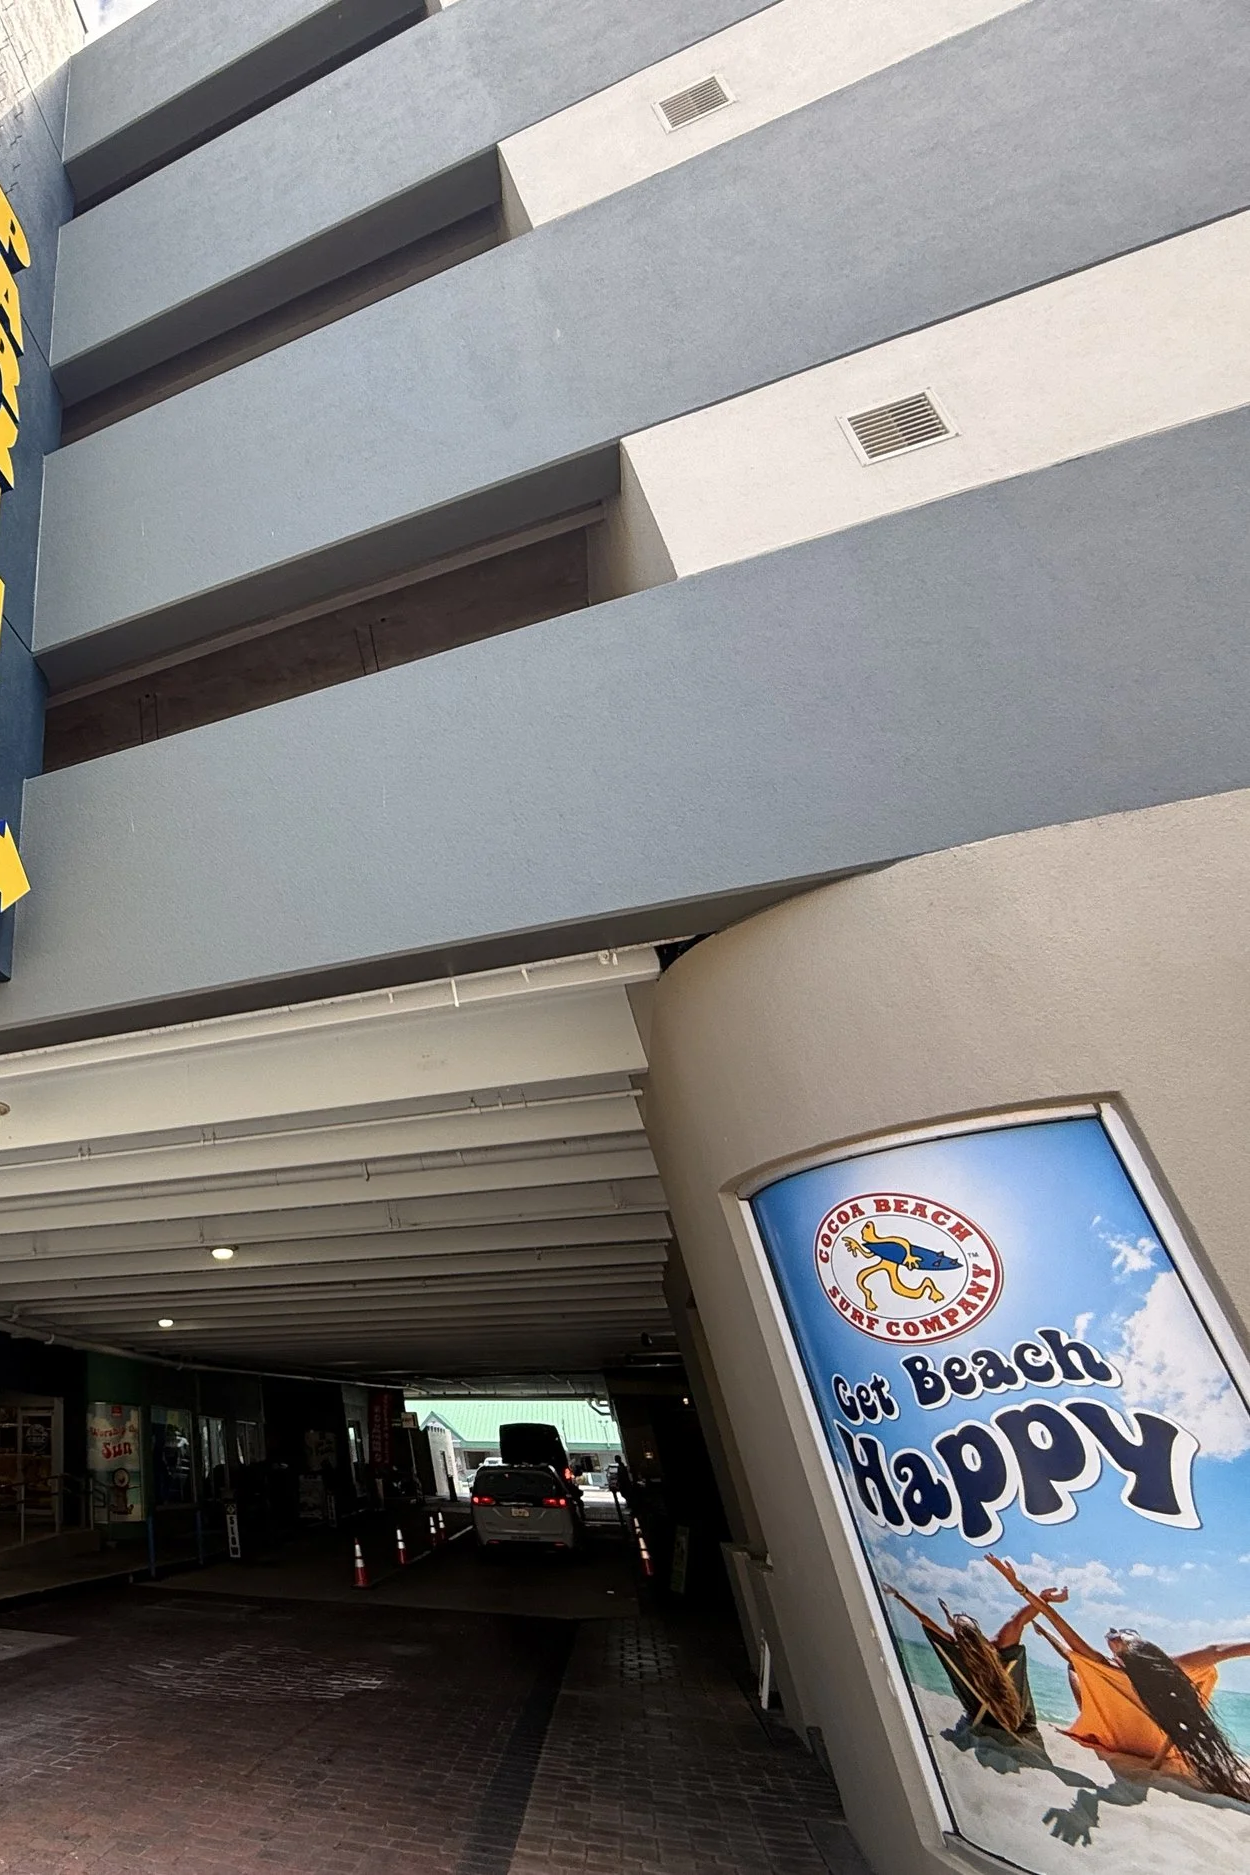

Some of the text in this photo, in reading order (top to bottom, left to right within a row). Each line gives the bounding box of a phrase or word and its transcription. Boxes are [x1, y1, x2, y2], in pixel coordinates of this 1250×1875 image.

[819, 1199, 973, 1263] COCOA BEACH
[828, 1263, 991, 1336] SURF COMPANY
[833, 1328, 1114, 1423] Get Beach
[102, 1442, 133, 1459] Sun
[836, 1400, 1190, 1541] Happy
